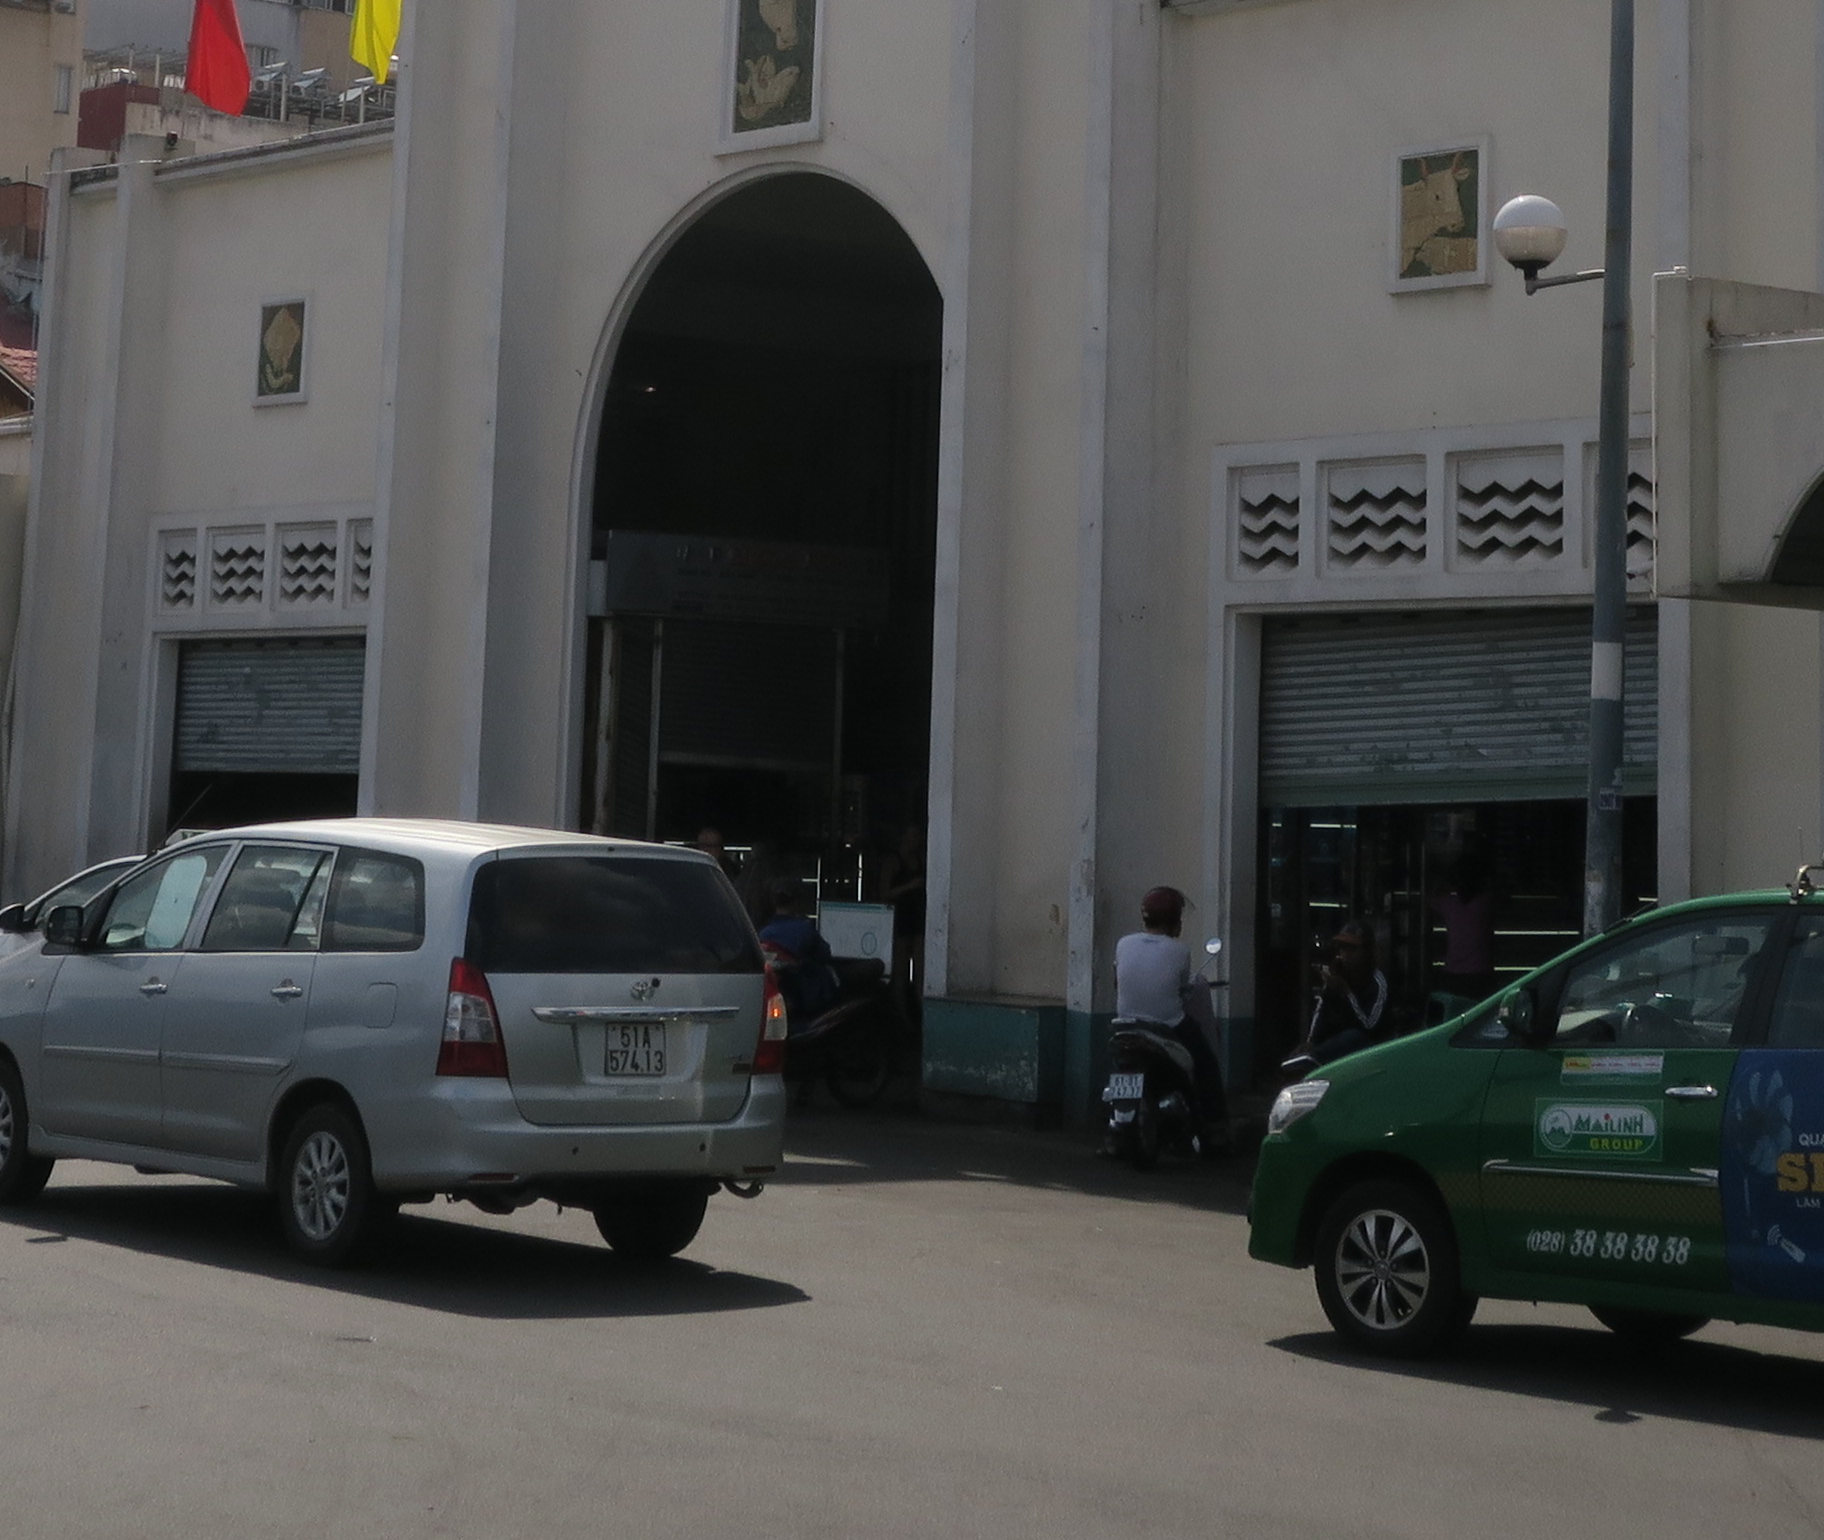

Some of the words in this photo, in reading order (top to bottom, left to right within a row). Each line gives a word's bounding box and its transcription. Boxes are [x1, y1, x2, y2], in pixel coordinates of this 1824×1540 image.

[620, 1025, 652, 1049] 51A
[609, 1049, 664, 1073] 574.13
[1590, 1137, 1644, 1150] GROUP
[1527, 1229, 1566, 1252] (028)
[1570, 1228, 1598, 1257] 38
[1600, 1231, 1629, 1260] 38
[1631, 1234, 1660, 1263] 38
[1662, 1236, 1692, 1265] 38
